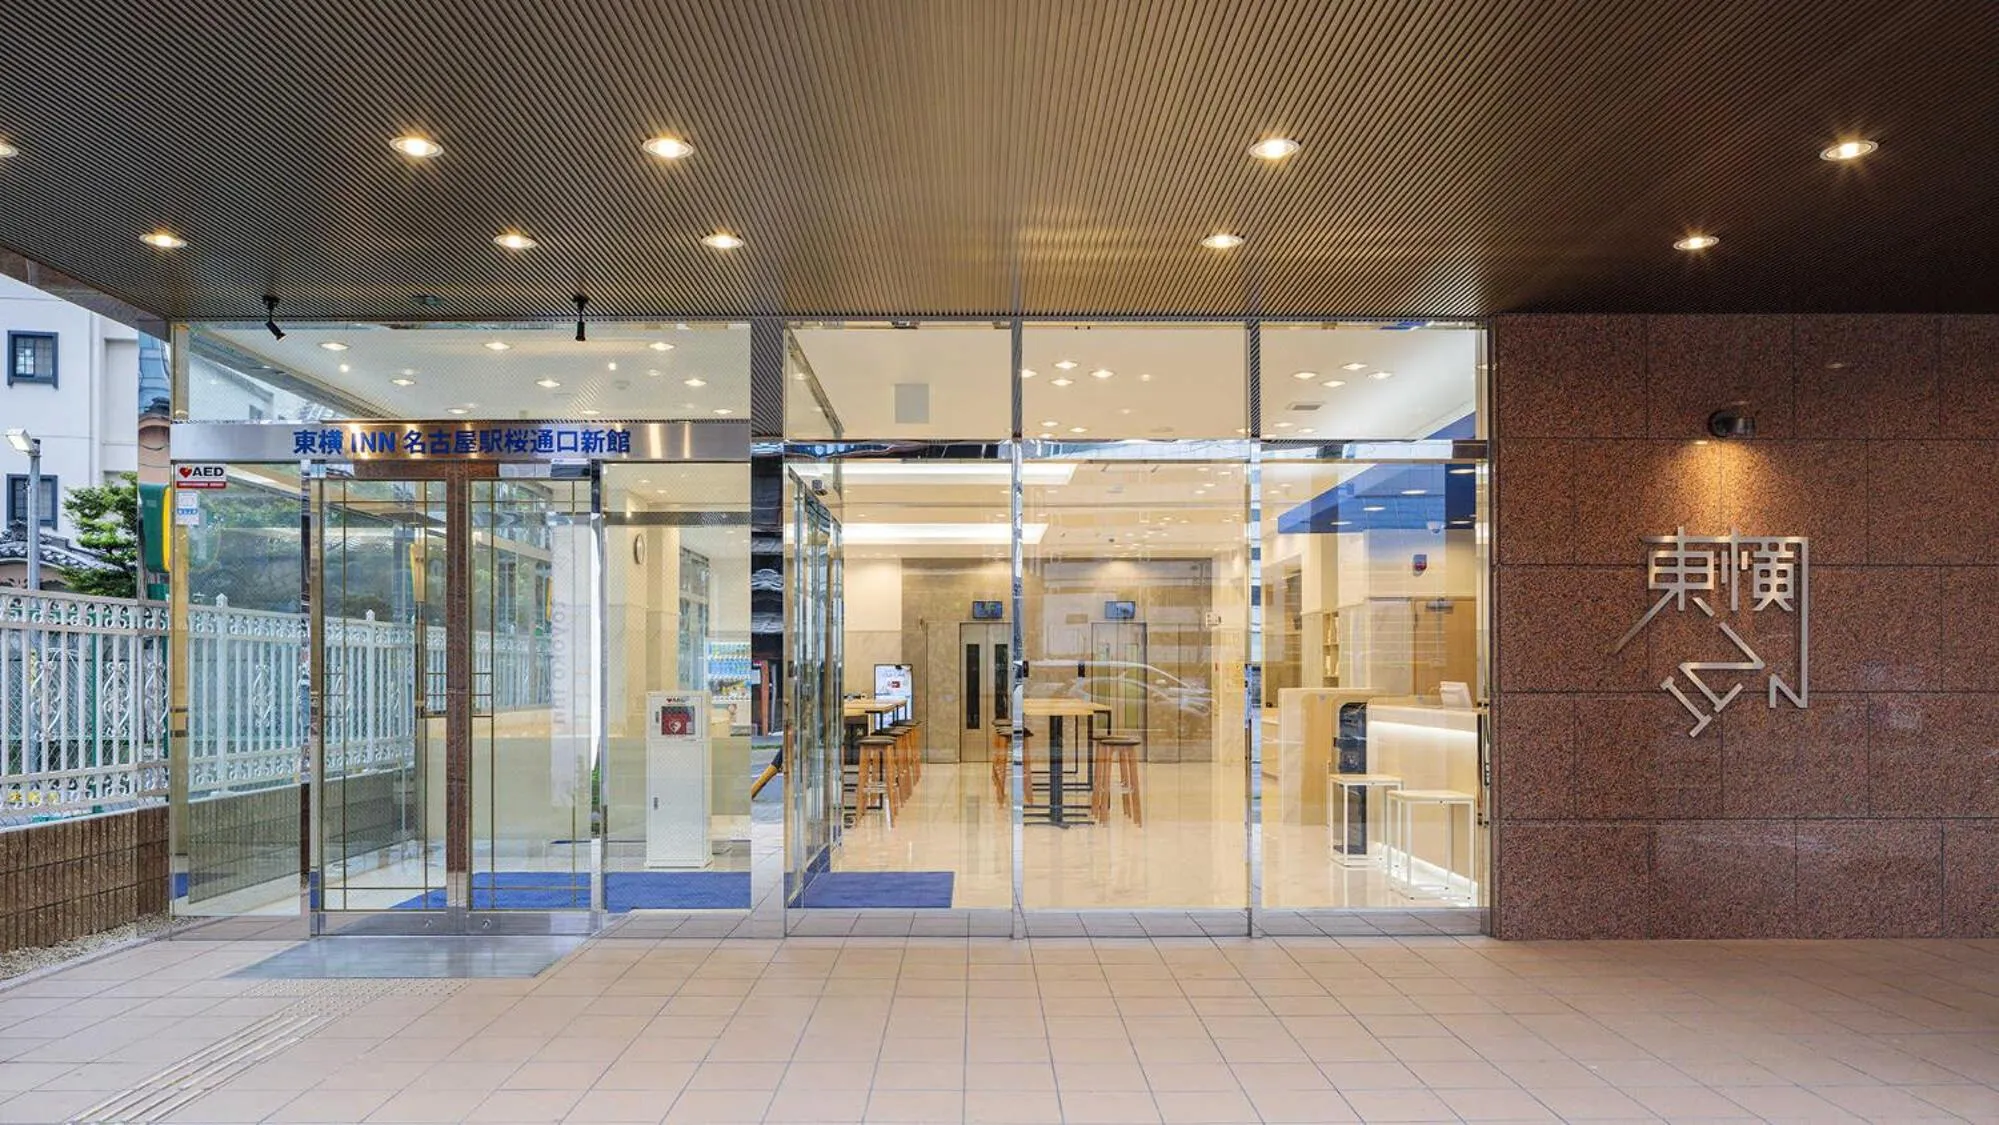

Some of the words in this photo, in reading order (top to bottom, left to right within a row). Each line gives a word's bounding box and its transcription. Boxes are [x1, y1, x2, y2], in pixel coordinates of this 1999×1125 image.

[293, 429, 343, 455] 東横
[351, 431, 396, 453] INN
[403, 428, 631, 454] 名古屋駅桜通口新館
[192, 467, 224, 477] AED
